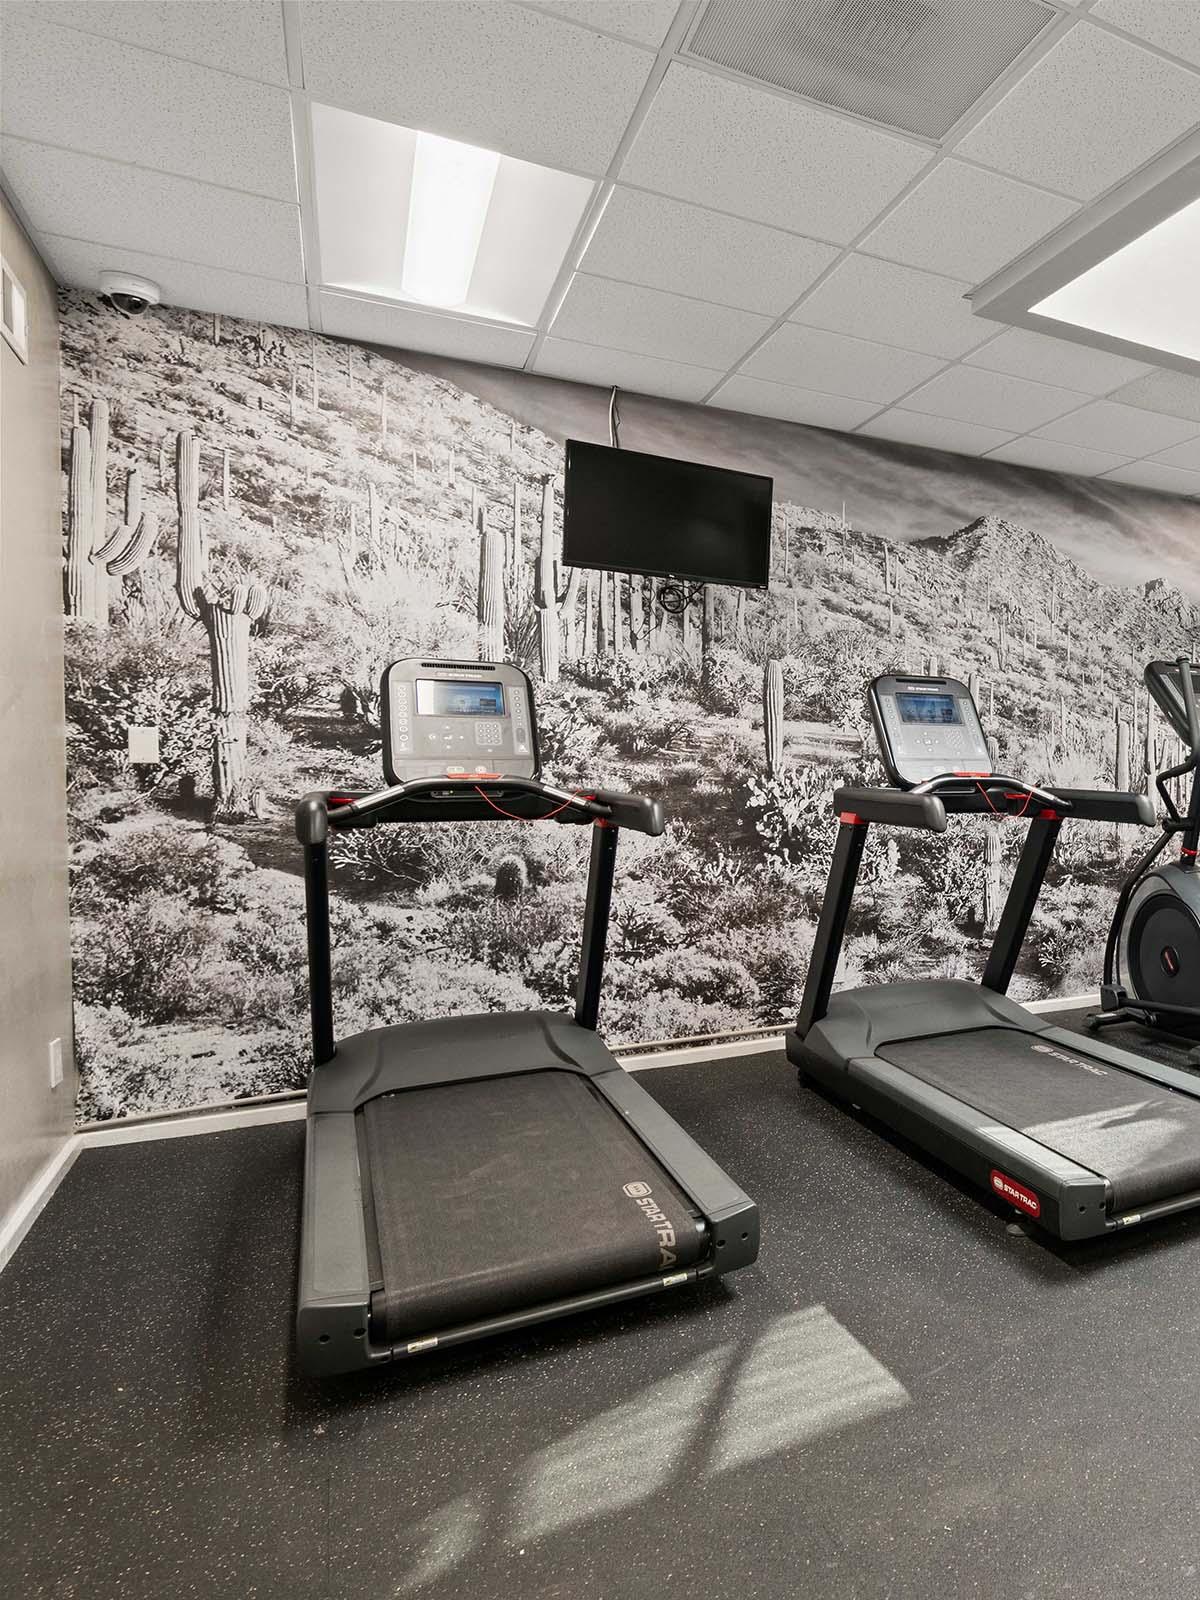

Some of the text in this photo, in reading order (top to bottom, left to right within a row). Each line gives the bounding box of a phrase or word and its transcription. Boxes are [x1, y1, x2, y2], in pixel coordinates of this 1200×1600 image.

[1048, 1051, 1108, 1076] STAR TRAC
[1003, 1183, 1038, 1210] STAR TRAC
[636, 1197, 667, 1222] STAR
[654, 1220, 677, 1270] TRA
